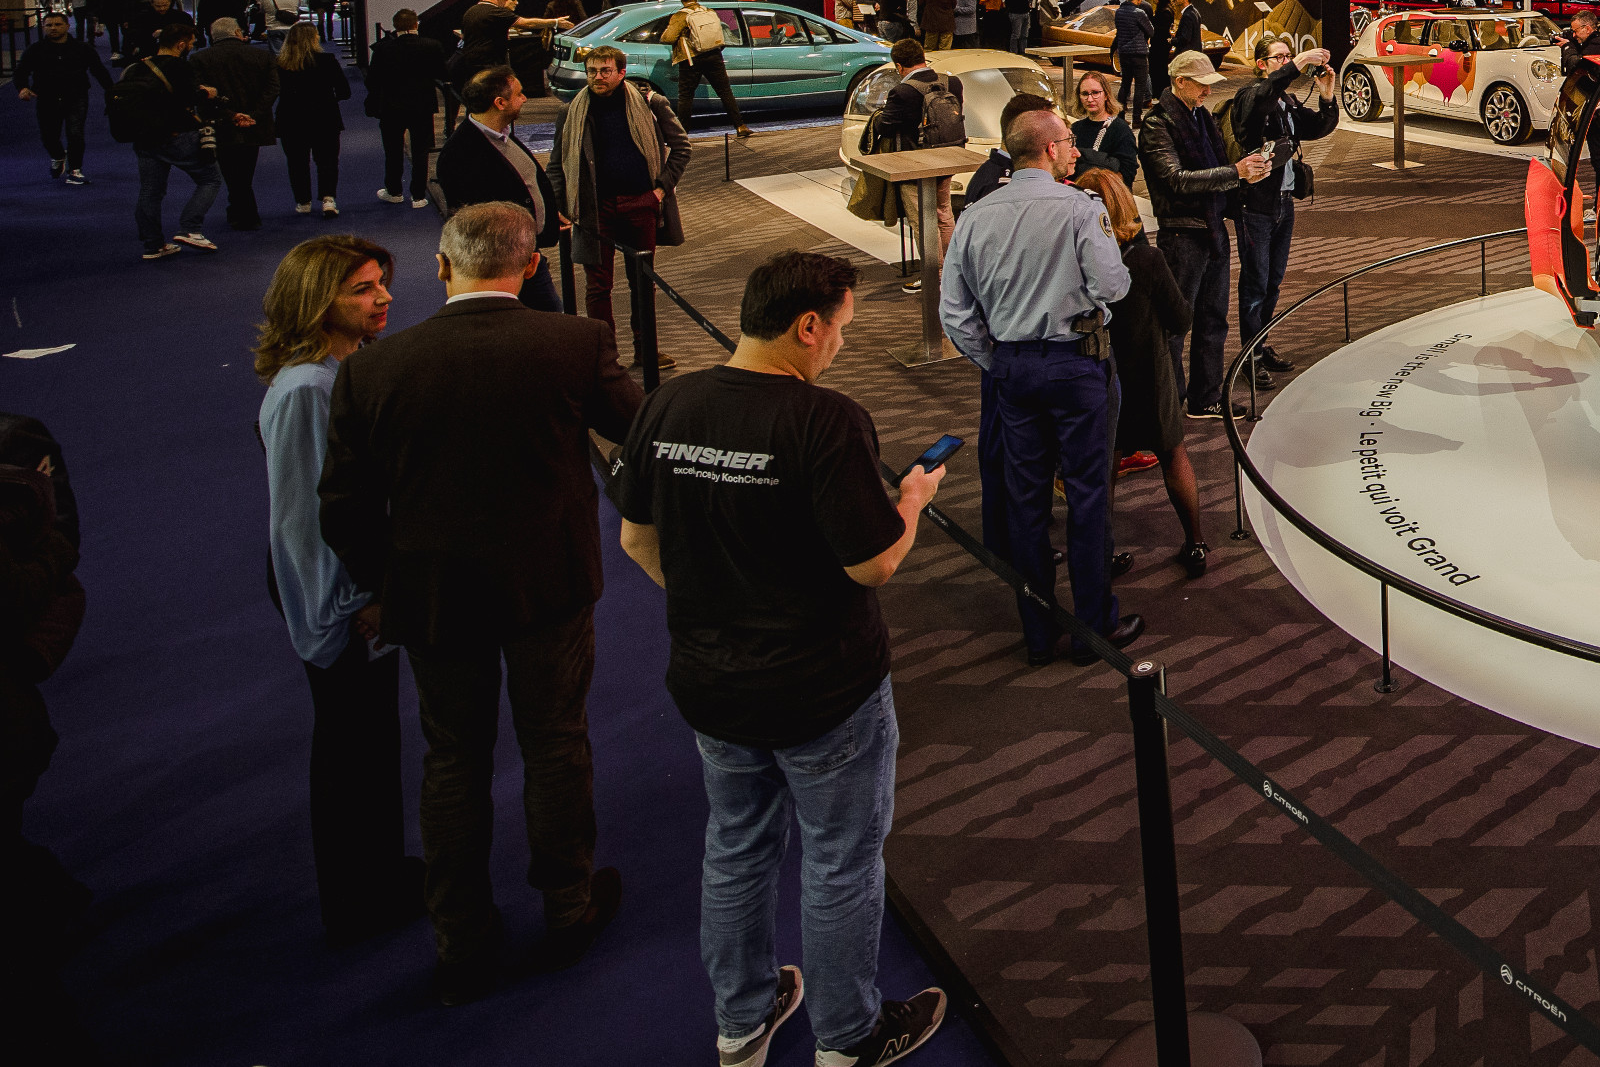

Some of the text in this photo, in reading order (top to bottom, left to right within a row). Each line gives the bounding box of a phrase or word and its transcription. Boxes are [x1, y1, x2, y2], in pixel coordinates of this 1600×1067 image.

[1352, 333, 1481, 587] Small is the new Big Le petit qui voit Grand
[1515, 979, 1567, 1023] CITROËN
